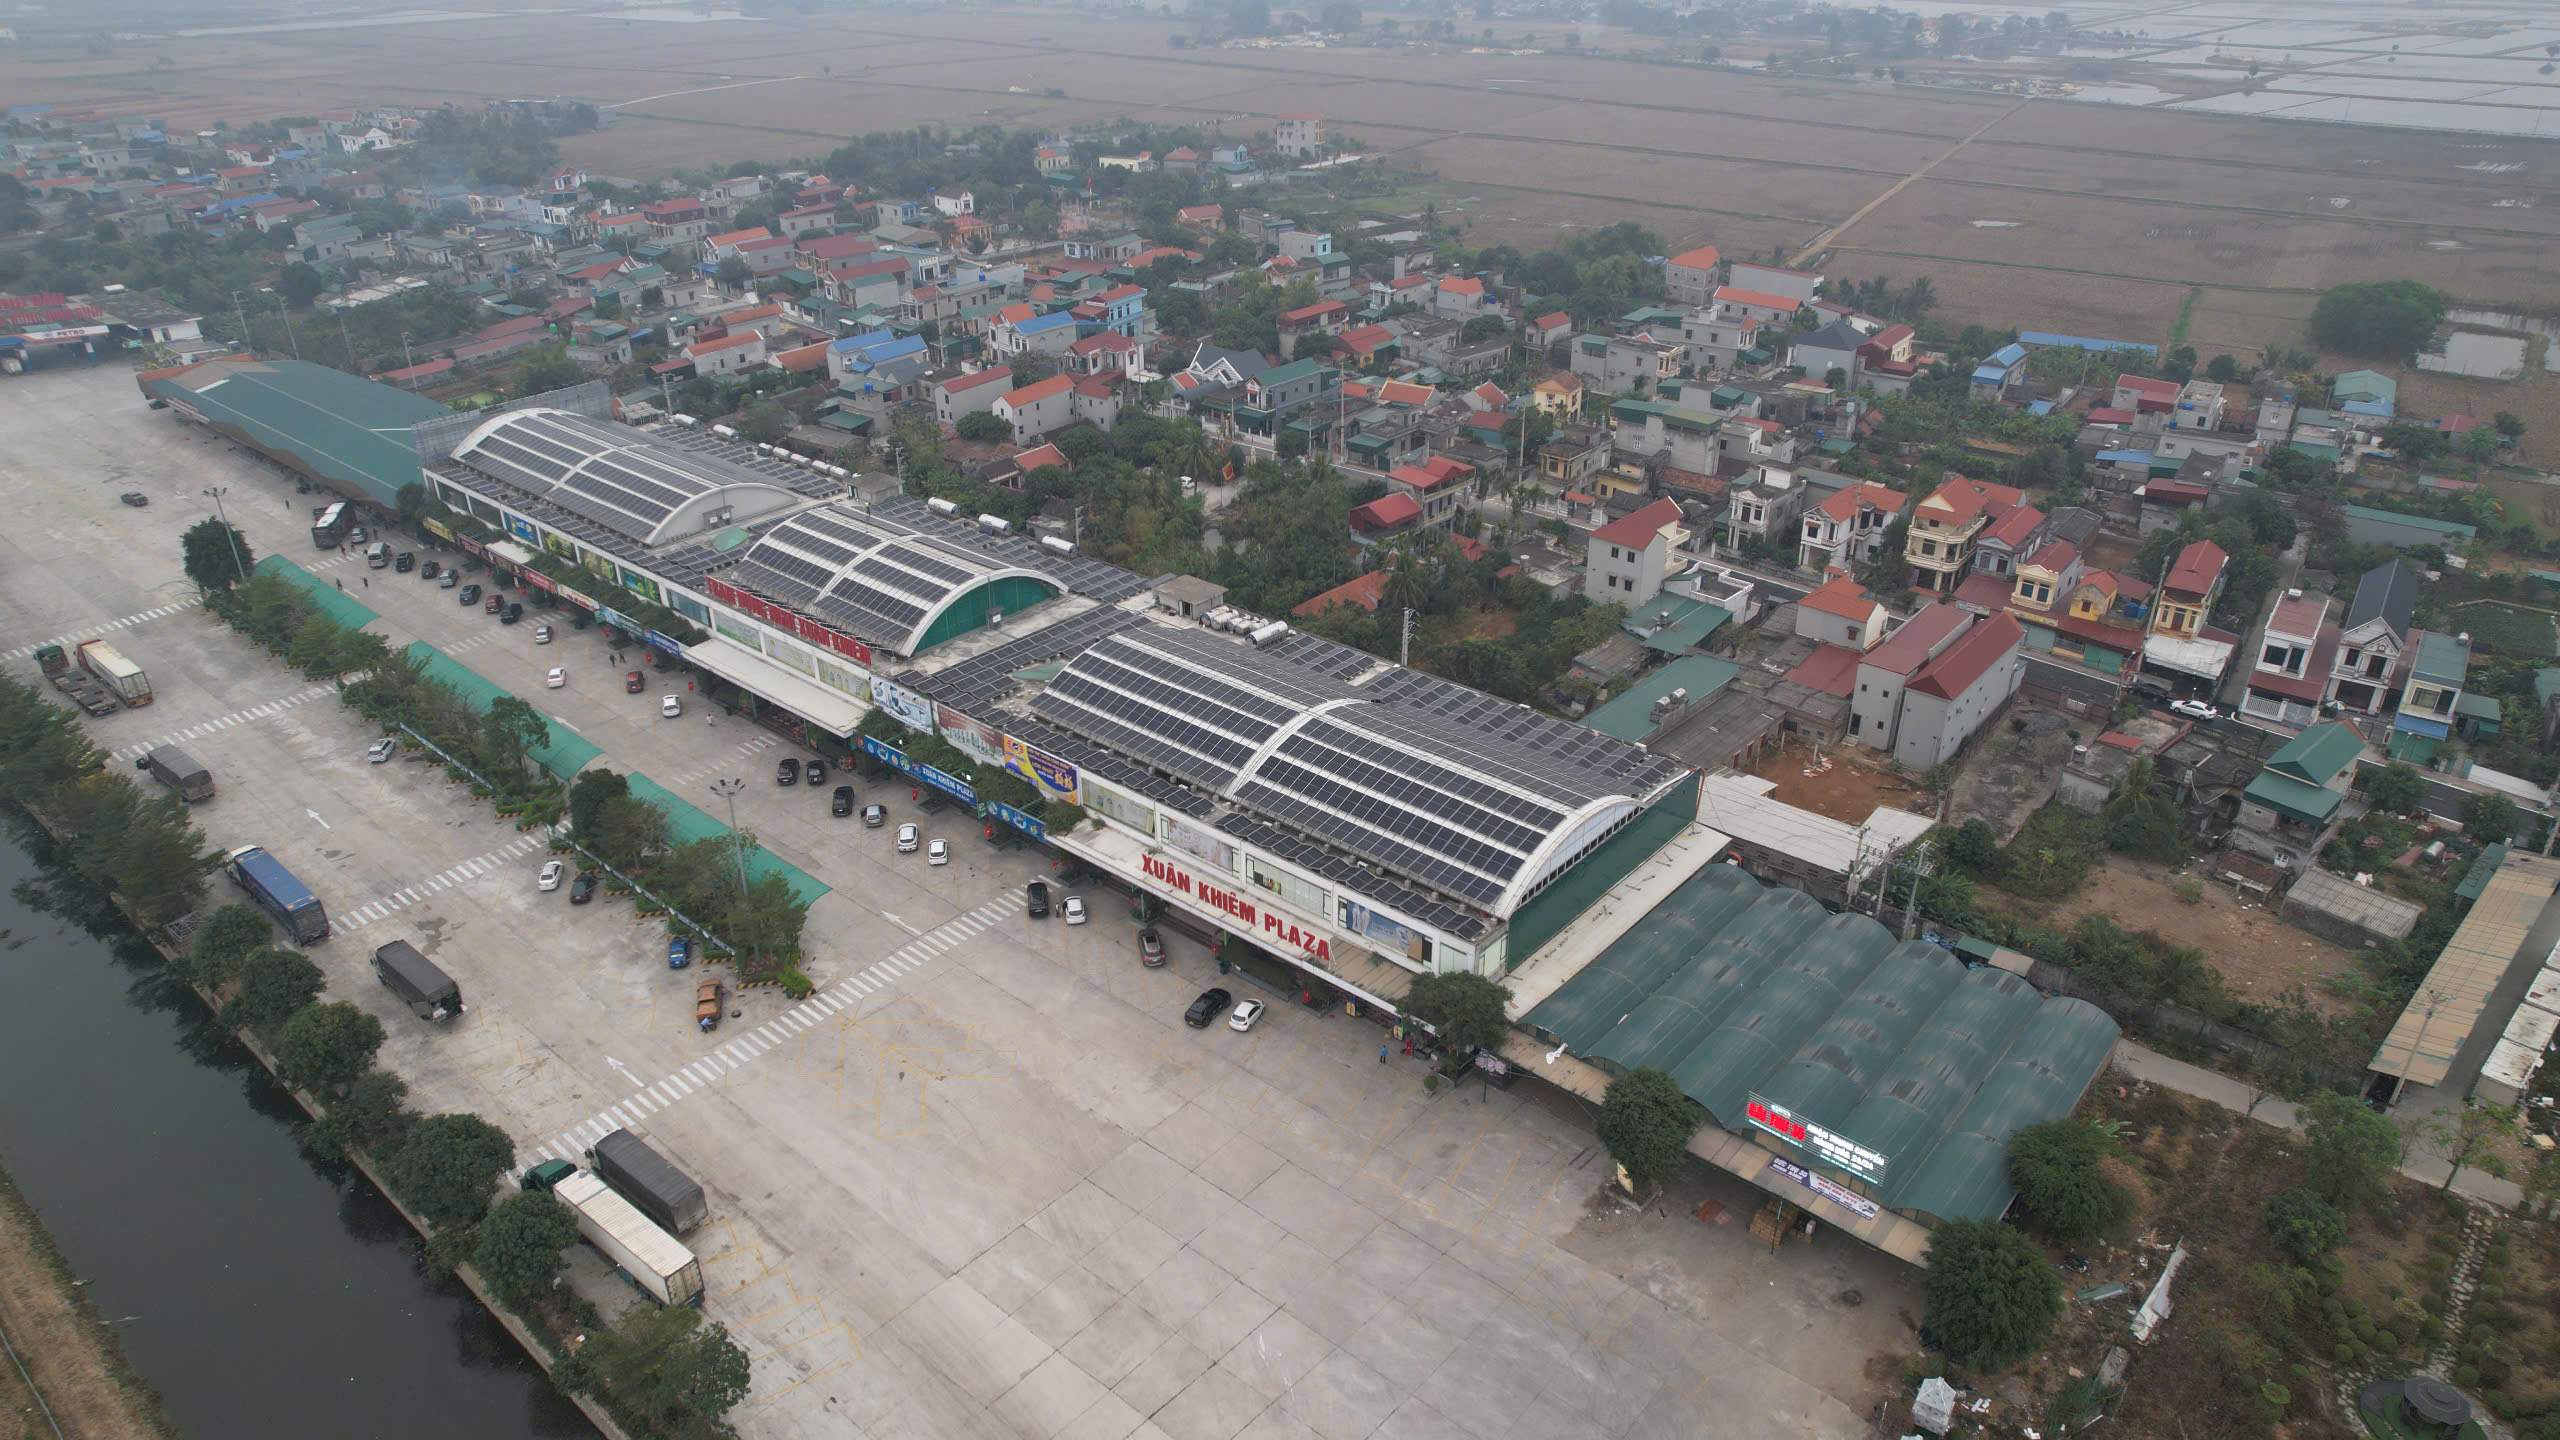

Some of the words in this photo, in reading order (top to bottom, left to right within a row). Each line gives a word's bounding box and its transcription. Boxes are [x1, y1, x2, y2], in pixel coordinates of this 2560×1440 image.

[57, 329, 85, 337] PETRO
[922, 766, 937, 780] XUÂN
[937, 774, 956, 789] KHIÊM
[956, 783, 974, 798] PLAZA
[1142, 853, 1190, 894] XUÂN
[1198, 881, 1256, 925] KHIÊM
[1264, 912, 1330, 961] PLAZA
[1829, 1134, 1855, 1152] TRUNG
